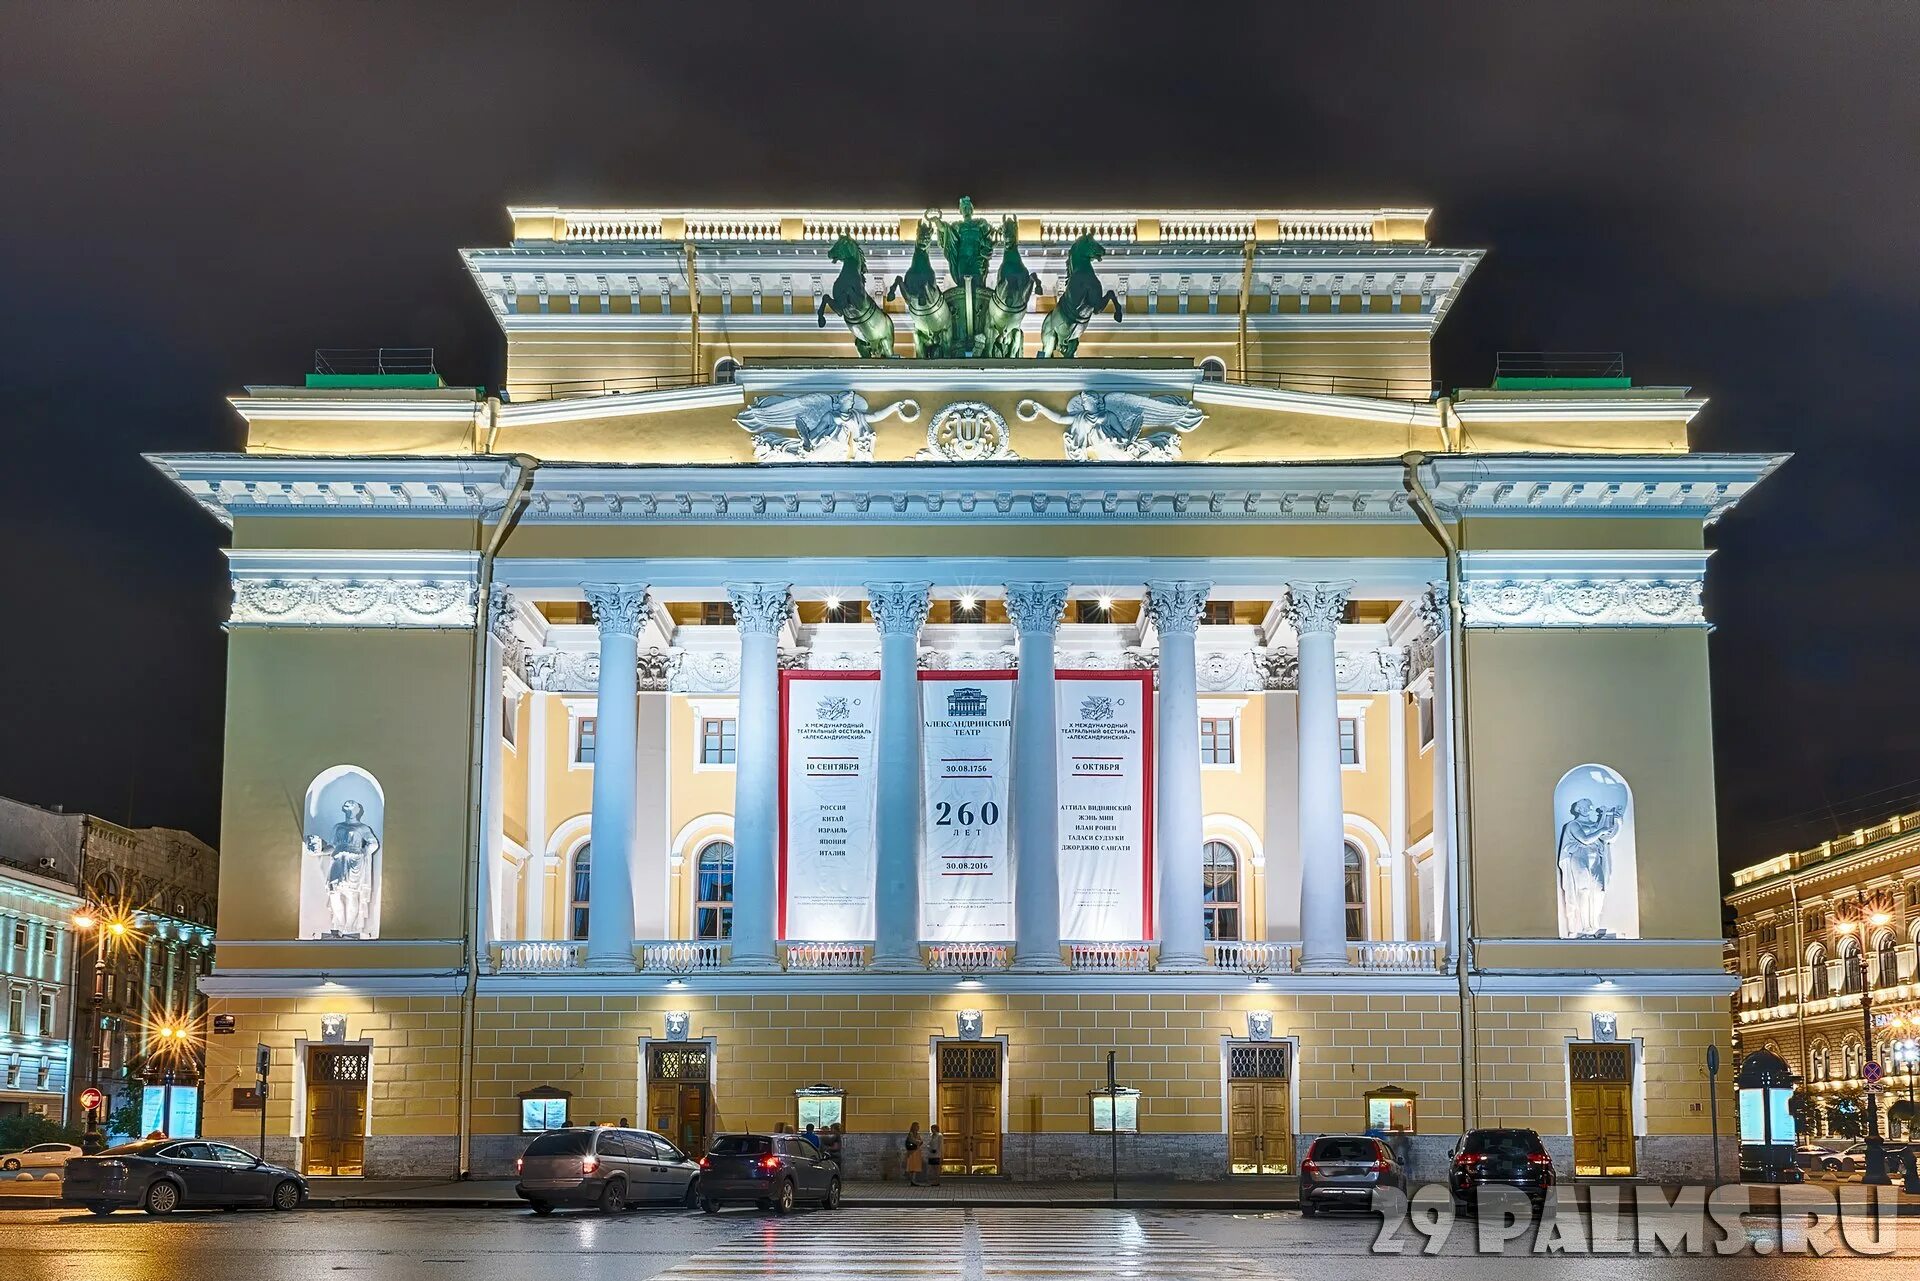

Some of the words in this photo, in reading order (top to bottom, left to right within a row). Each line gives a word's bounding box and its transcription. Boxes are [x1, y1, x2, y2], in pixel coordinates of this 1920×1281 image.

[924, 720, 1011, 728] АЛЕКСАНДРИНСКИЙ
[817, 763, 859, 771] СЕНТЯБРЯ
[936, 802, 998, 825] 260
